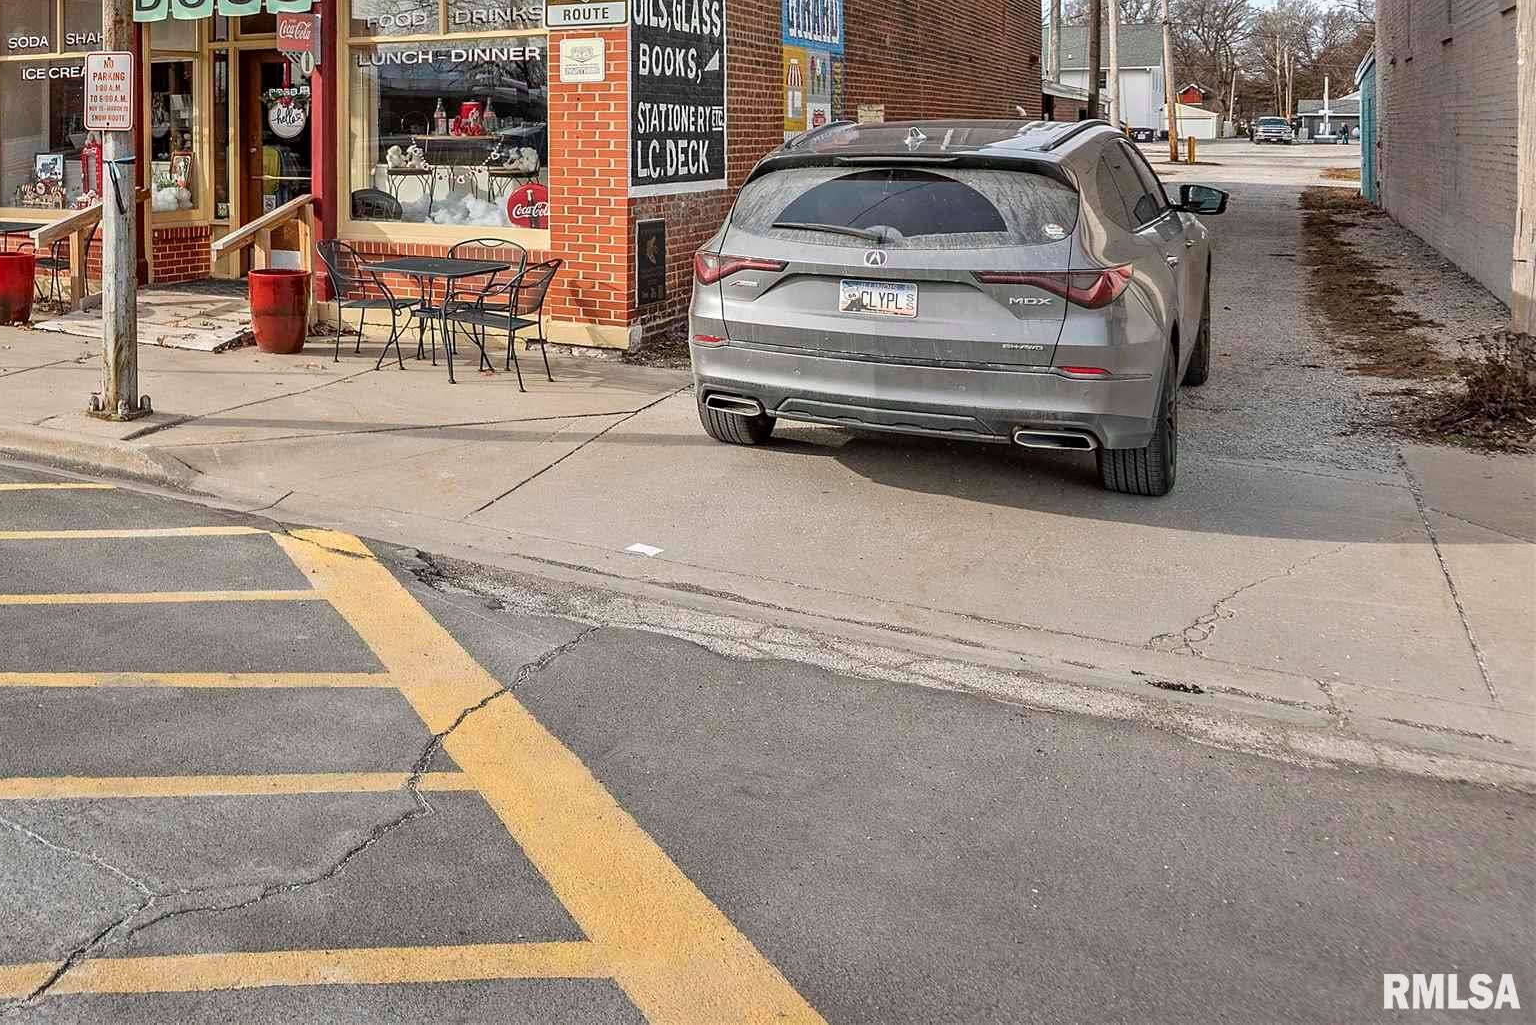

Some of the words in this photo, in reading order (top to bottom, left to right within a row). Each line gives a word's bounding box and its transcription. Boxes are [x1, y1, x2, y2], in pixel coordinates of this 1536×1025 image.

[366, 12, 428, 29] FOOD
[454, 6, 544, 24] DRINKS
[563, 7, 610, 22] ROUTE
[8, 35, 49, 49] SODA
[104, 59, 114, 68] NO
[359, 50, 433, 66] LUNCH
[451, 47, 541, 63] DINNER
[639, 43, 702, 84] BOOKS,
[22, 68, 47, 80] ICE
[93, 71, 125, 81] PARKING
[272, 108, 297, 125] hello
[638, 101, 711, 134] STATIONERY
[666, 139, 709, 175] DECK
[861, 291, 902, 310] CLYPL
[1009, 297, 1052, 305] MDX
